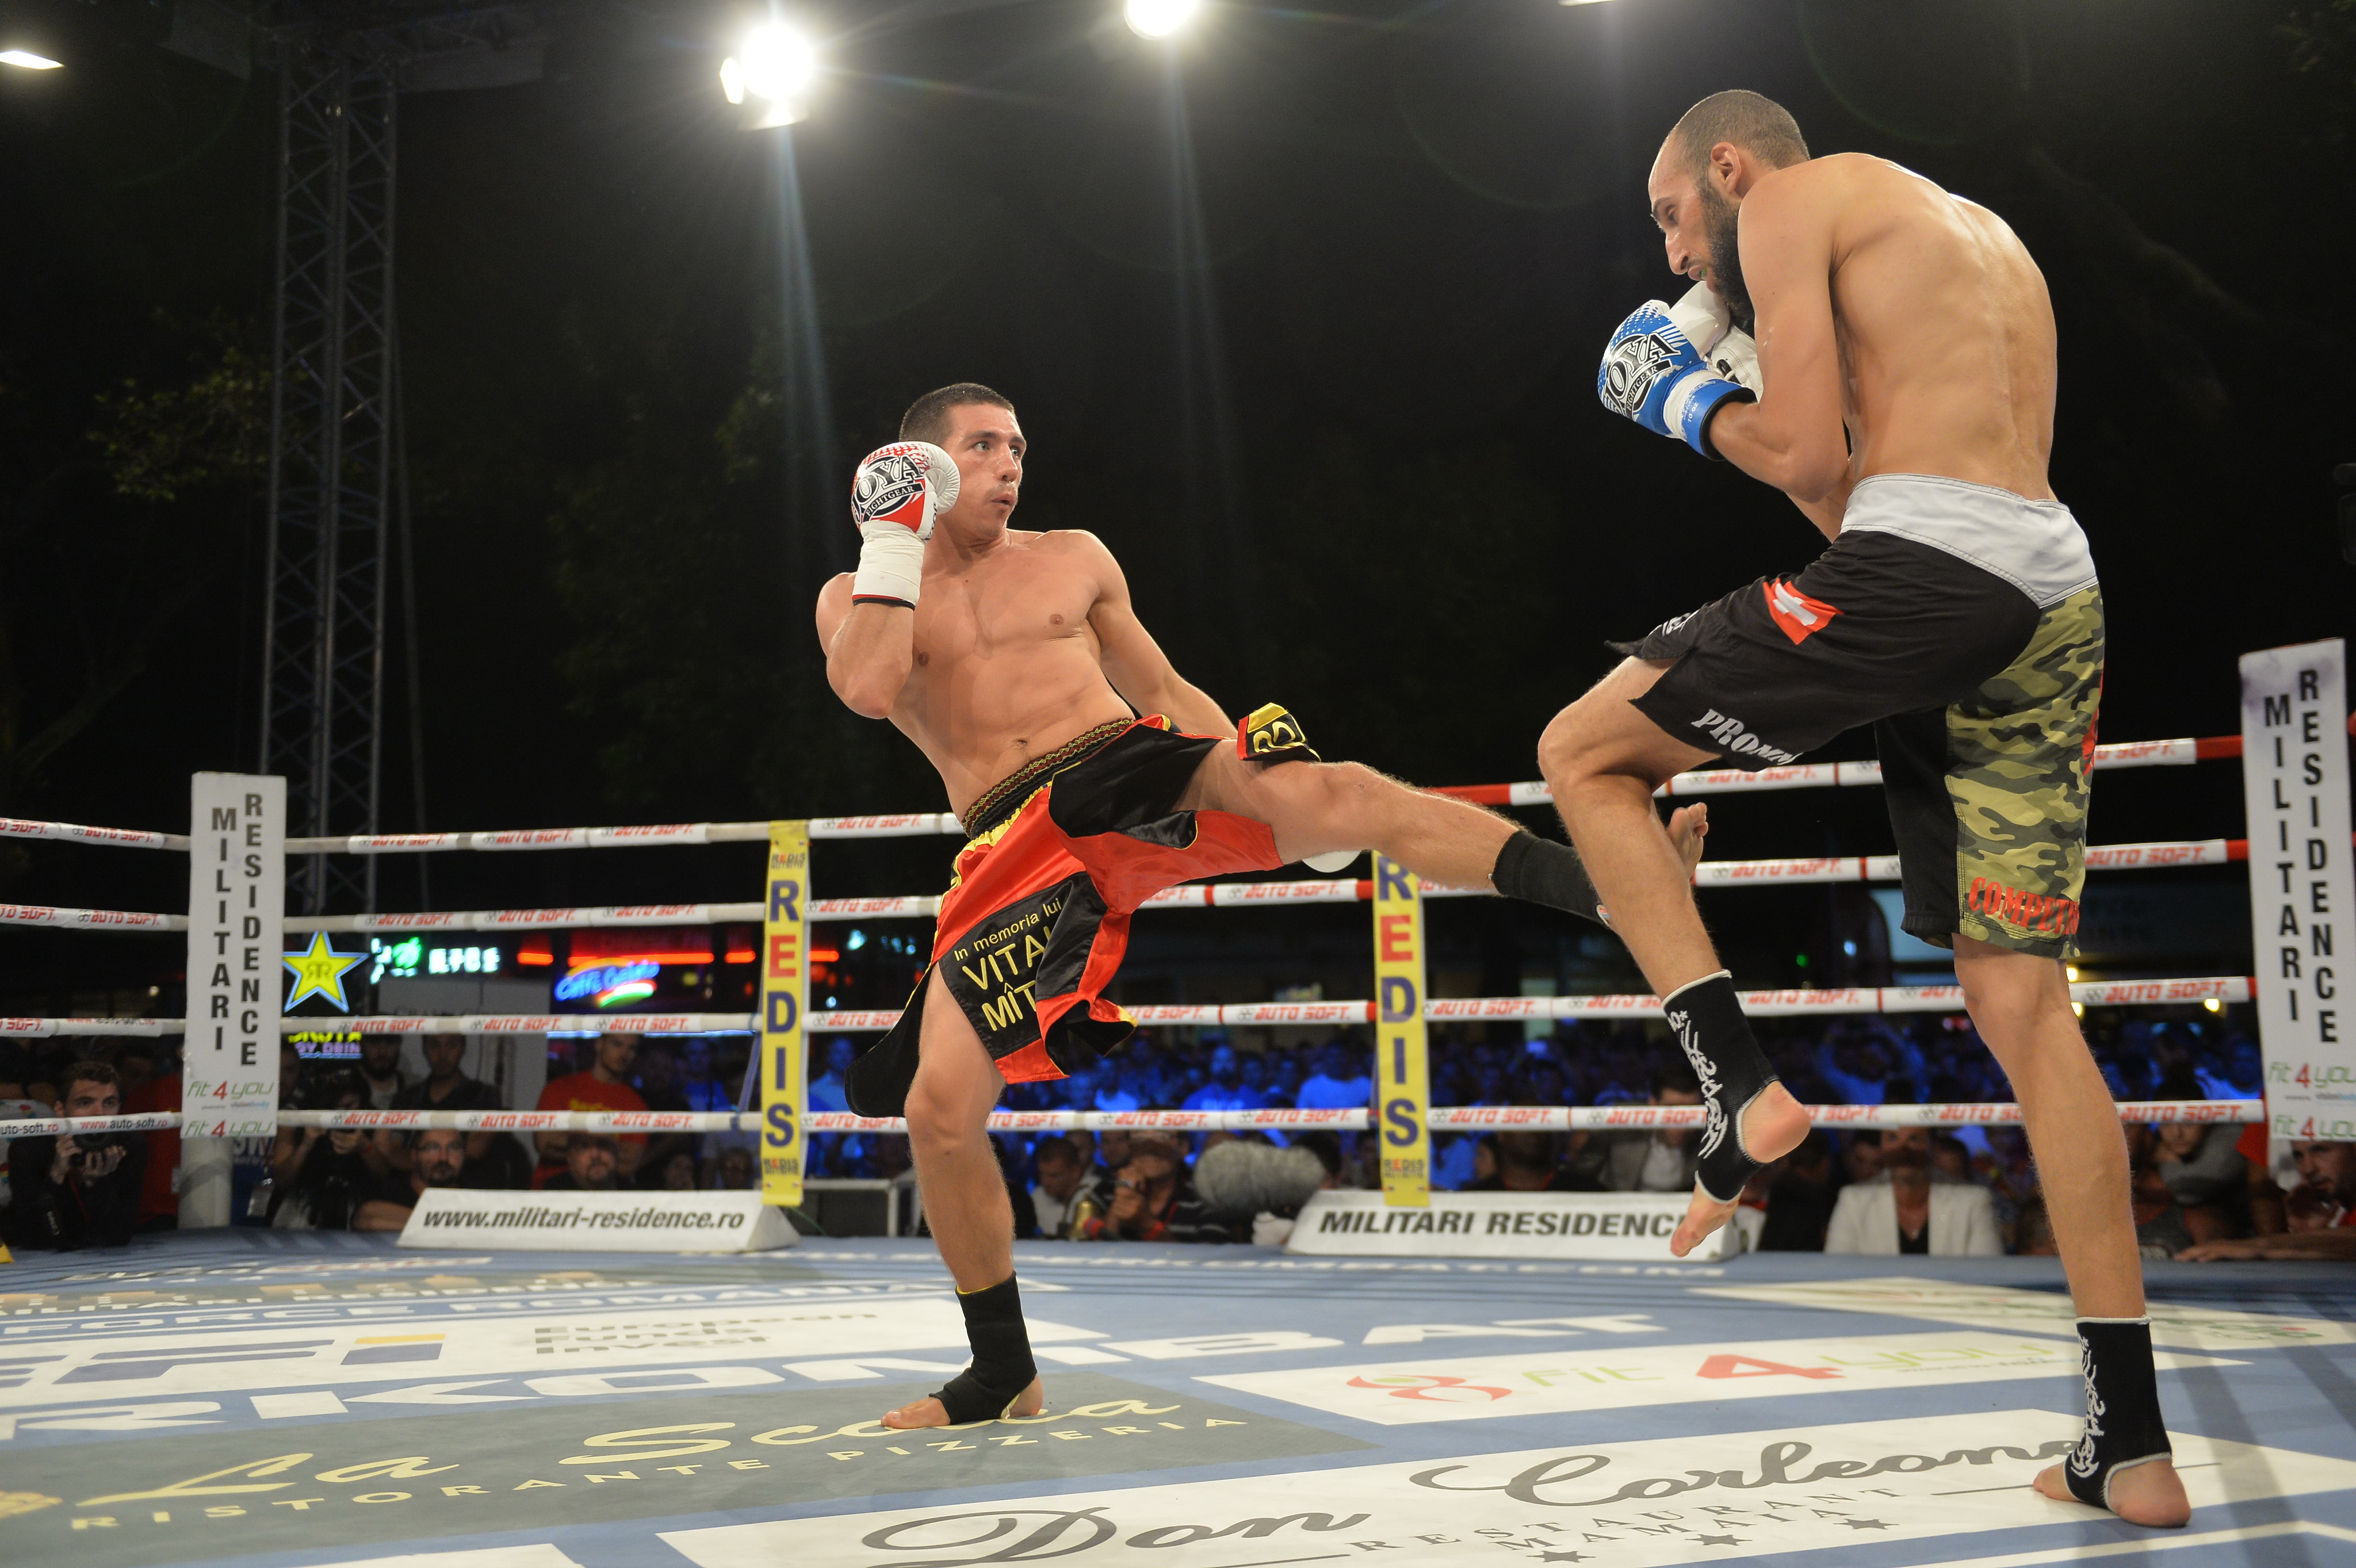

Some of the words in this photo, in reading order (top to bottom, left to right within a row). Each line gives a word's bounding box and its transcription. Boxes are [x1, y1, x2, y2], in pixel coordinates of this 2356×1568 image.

[1626, 365, 1658, 412] FIGHTGEAR
[866, 486, 915, 517] FIGHTGEAR
[2264, 694, 2301, 1021] MILITARI
[2299, 669, 2338, 1043] RESIDENCE
[211, 807, 237, 1050] MILITARI
[240, 793, 262, 1066] RESIDENCE
[954, 948, 969, 961] In
[973, 912, 1040, 952] memoria
[1042, 898, 1062, 917] lui
[766, 880, 799, 1146] REDIS
[213, 1080, 228, 1100] 4
[231, 1082, 274, 1100] you
[2295, 1063, 2311, 1088] 4
[211, 1120, 226, 1137] 4
[422, 1207, 745, 1229] www.militari-residence.ro
[1319, 1210, 1475, 1234] MILITARI
[1485, 1211, 1683, 1237] RESIDENC
[1695, 1354, 1847, 1380] 4
[70, 1459, 771, 1530] RISTORANTE
[826, 1418, 1248, 1461] PIZZERIA
[76, 1453, 460, 1507] La
[1345, 1488, 1908, 1552] RESTAURANT
[1490, 1508, 1856, 1551] MAMAIA
